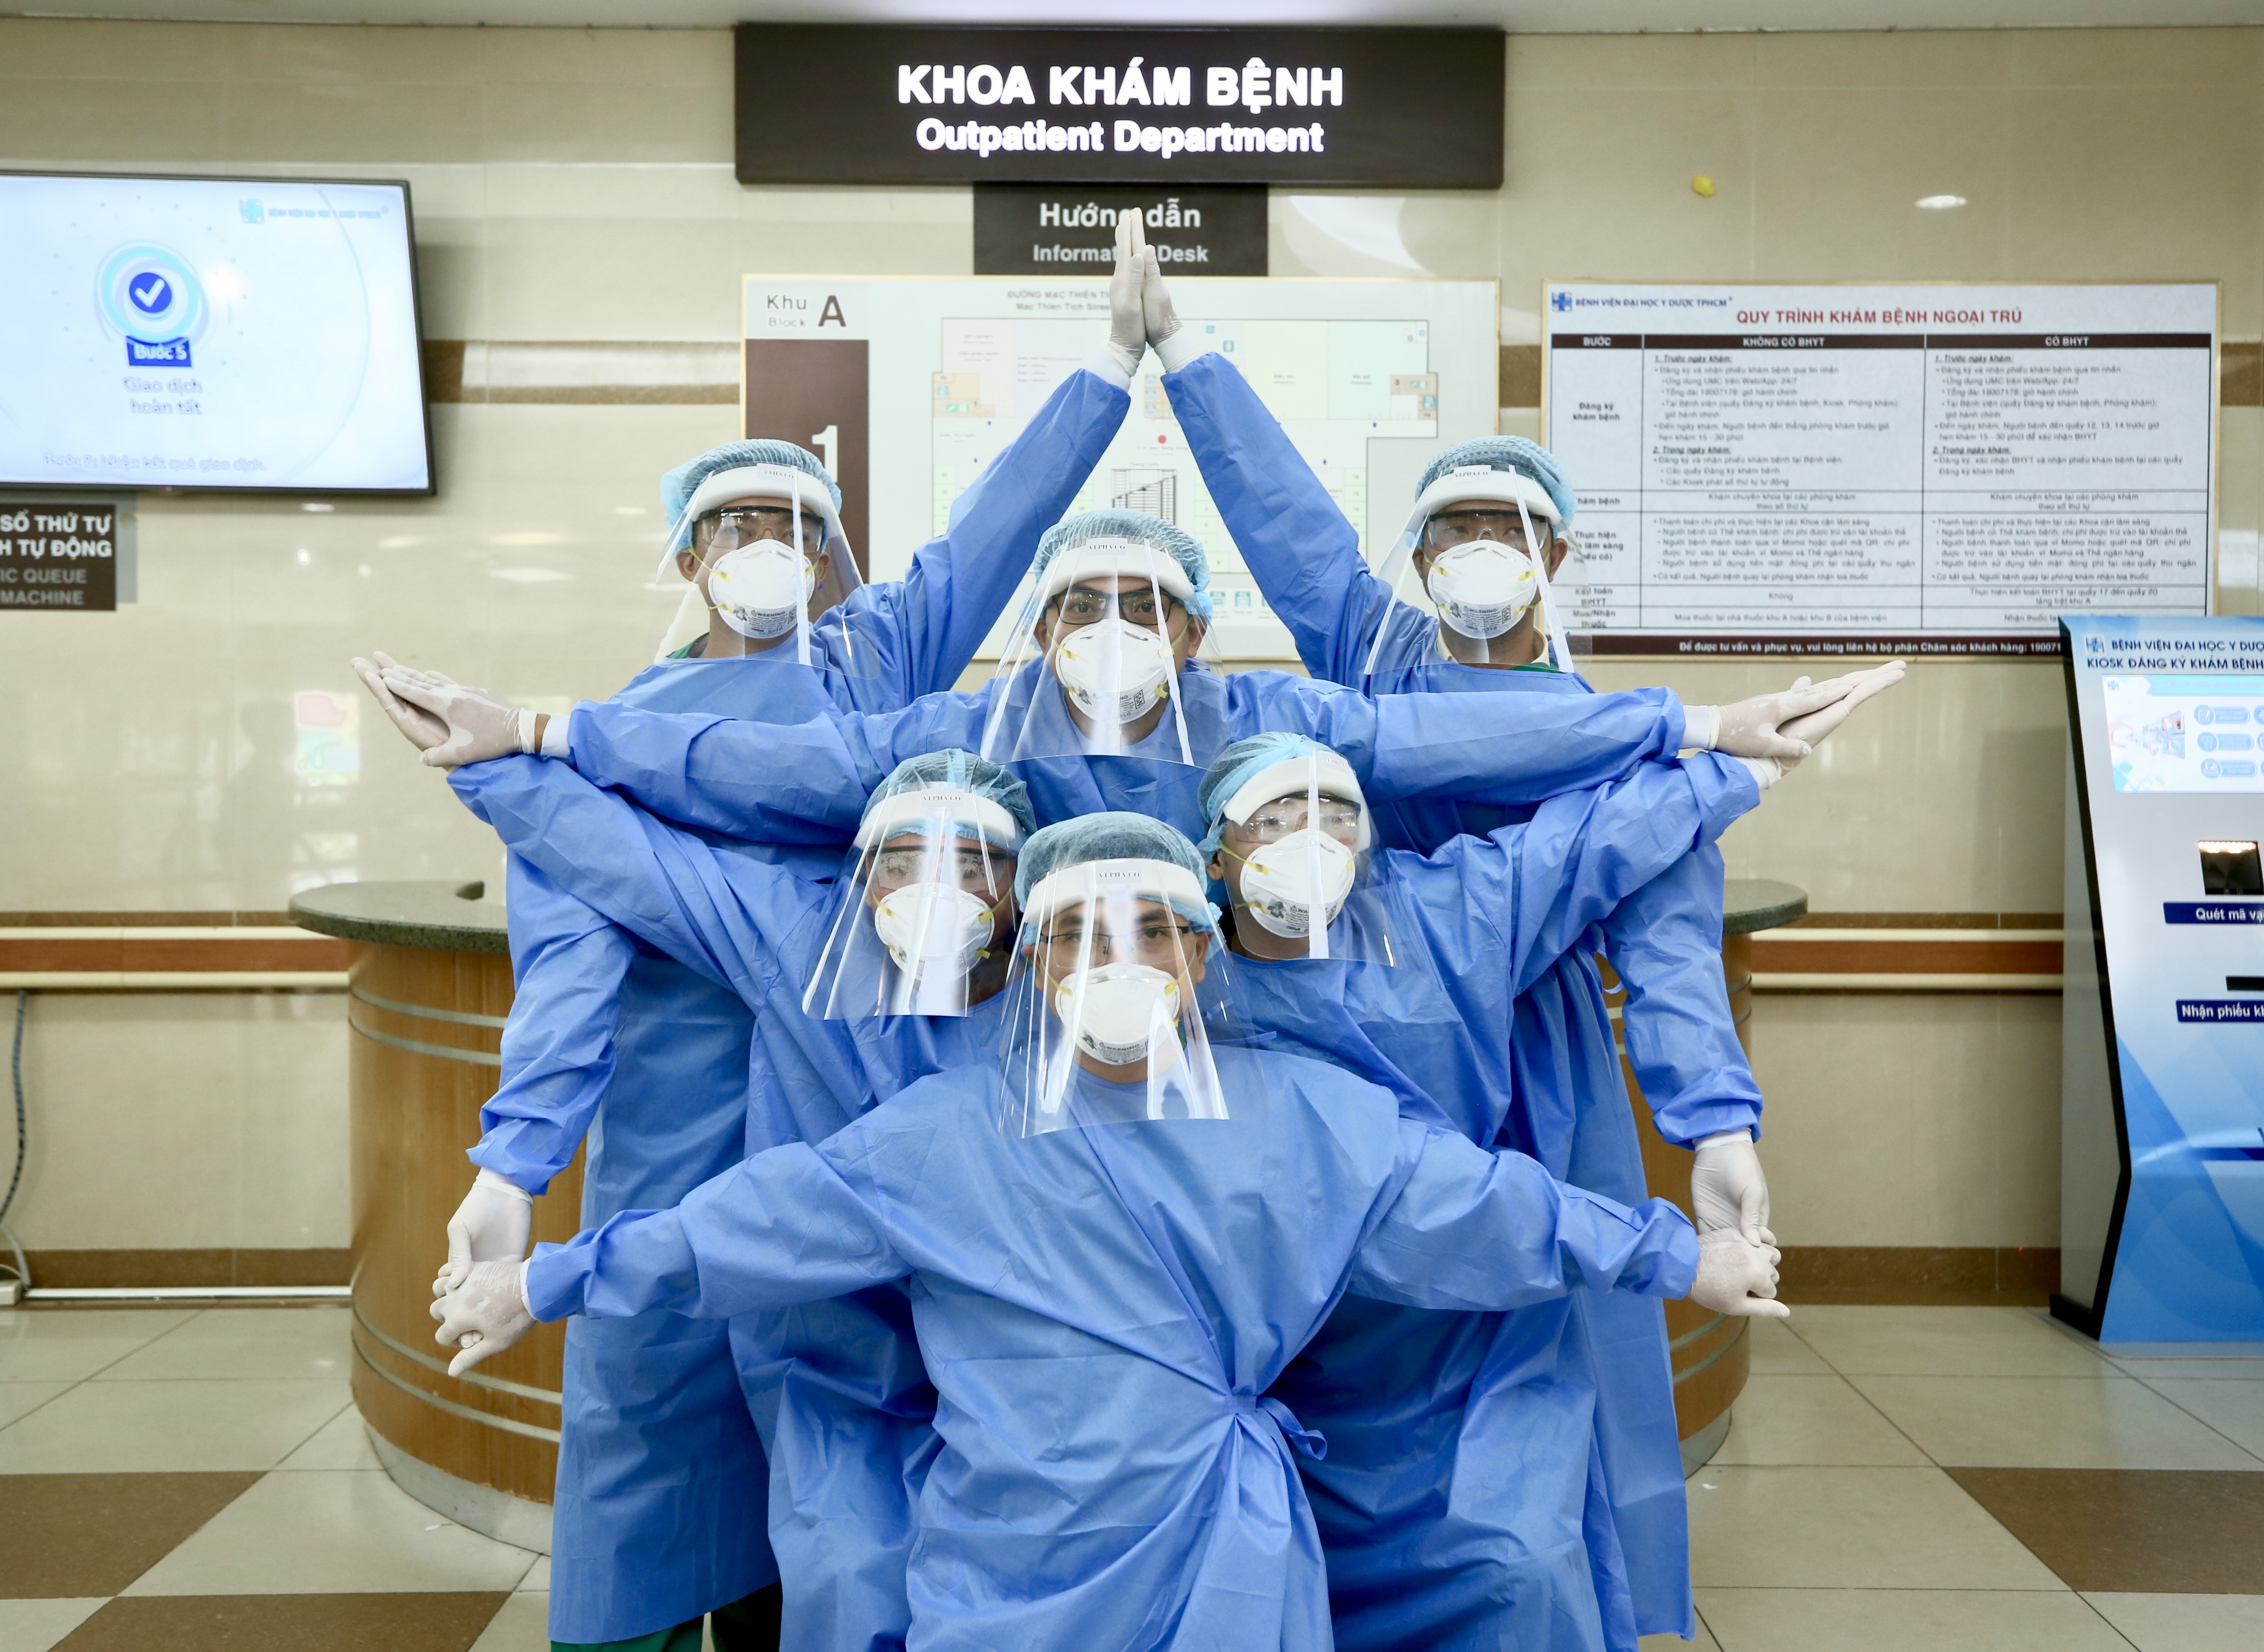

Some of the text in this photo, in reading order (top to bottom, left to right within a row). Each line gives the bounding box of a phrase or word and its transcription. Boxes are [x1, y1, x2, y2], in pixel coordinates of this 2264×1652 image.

[898, 56, 1343, 114] KHOA KHÁM BỆNH
[916, 118, 1324, 159] Outpatient Department
[1146, 198, 1201, 228] dẫn
[1157, 244, 1208, 262] Desk
[767, 294, 847, 327] Khu A
[1575, 298, 1727, 307] BỆNH VIỆN ĐẠI HỌC Y DƯỢC TPHCM
[769, 317, 805, 327] Block
[1737, 308, 2022, 324] QUY TRÌNH KHÁM BỆNH NGOẠI TRÚ
[1583, 335, 1612, 347] BƯỚC
[1743, 334, 1824, 347] KHÔNG CÓ BHYT
[2045, 334, 2088, 346] CÓ BHYT
[1579, 402, 1614, 411] Đăng ký
[1598, 413, 1620, 421] bệnh
[812, 425, 838, 483] 1
[1599, 496, 1620, 505] bệnh
[0, 508, 30, 533] SỐ
[82, 513, 112, 536] TỰ
[17, 536, 47, 560] TỰ
[50, 535, 113, 560] ĐỘNG
[1603, 542, 1624, 551] sàng
[23, 568, 88, 584] QUEUE
[0, 589, 85, 606] MACHINE
[1679, 641, 1692, 652] Để
[1694, 642, 1717, 652] được
[1720, 642, 1730, 652] tư
[1731, 641, 1748, 652] vấn
[1751, 642, 1762, 652] và
[1764, 643, 1788, 653] phục
[1790, 643, 1804, 653] vụ,
[1806, 643, 1821, 652] vui
[1822, 643, 1844, 653] lòng
[1845, 642, 1863, 652] liên
[1865, 642, 1877, 652] hệ
[1880, 642, 1892, 653] bộ
[1894, 643, 1918, 653] phận
[1920, 642, 1948, 652] Chăm
[1950, 643, 1967, 652] sóc
[1969, 643, 1997, 652] khách
[2031, 642, 2060, 651] 190071
[2112, 640, 2141, 653] BỆNH
[2145, 640, 2171, 653] VIỆN
[2175, 641, 2195, 653] ĐẠI
[2199, 641, 2225, 653] HỌC
[2229, 641, 2236, 651] Y
[2087, 655, 2264, 672] KIOSK ĐĂNG KÝ KHÁM BỆNH
[2196, 907, 2264, 923] Quét mã vạ
[2182, 1004, 2214, 1020] Nhận
[2217, 1002, 2250, 1020] phiếu
